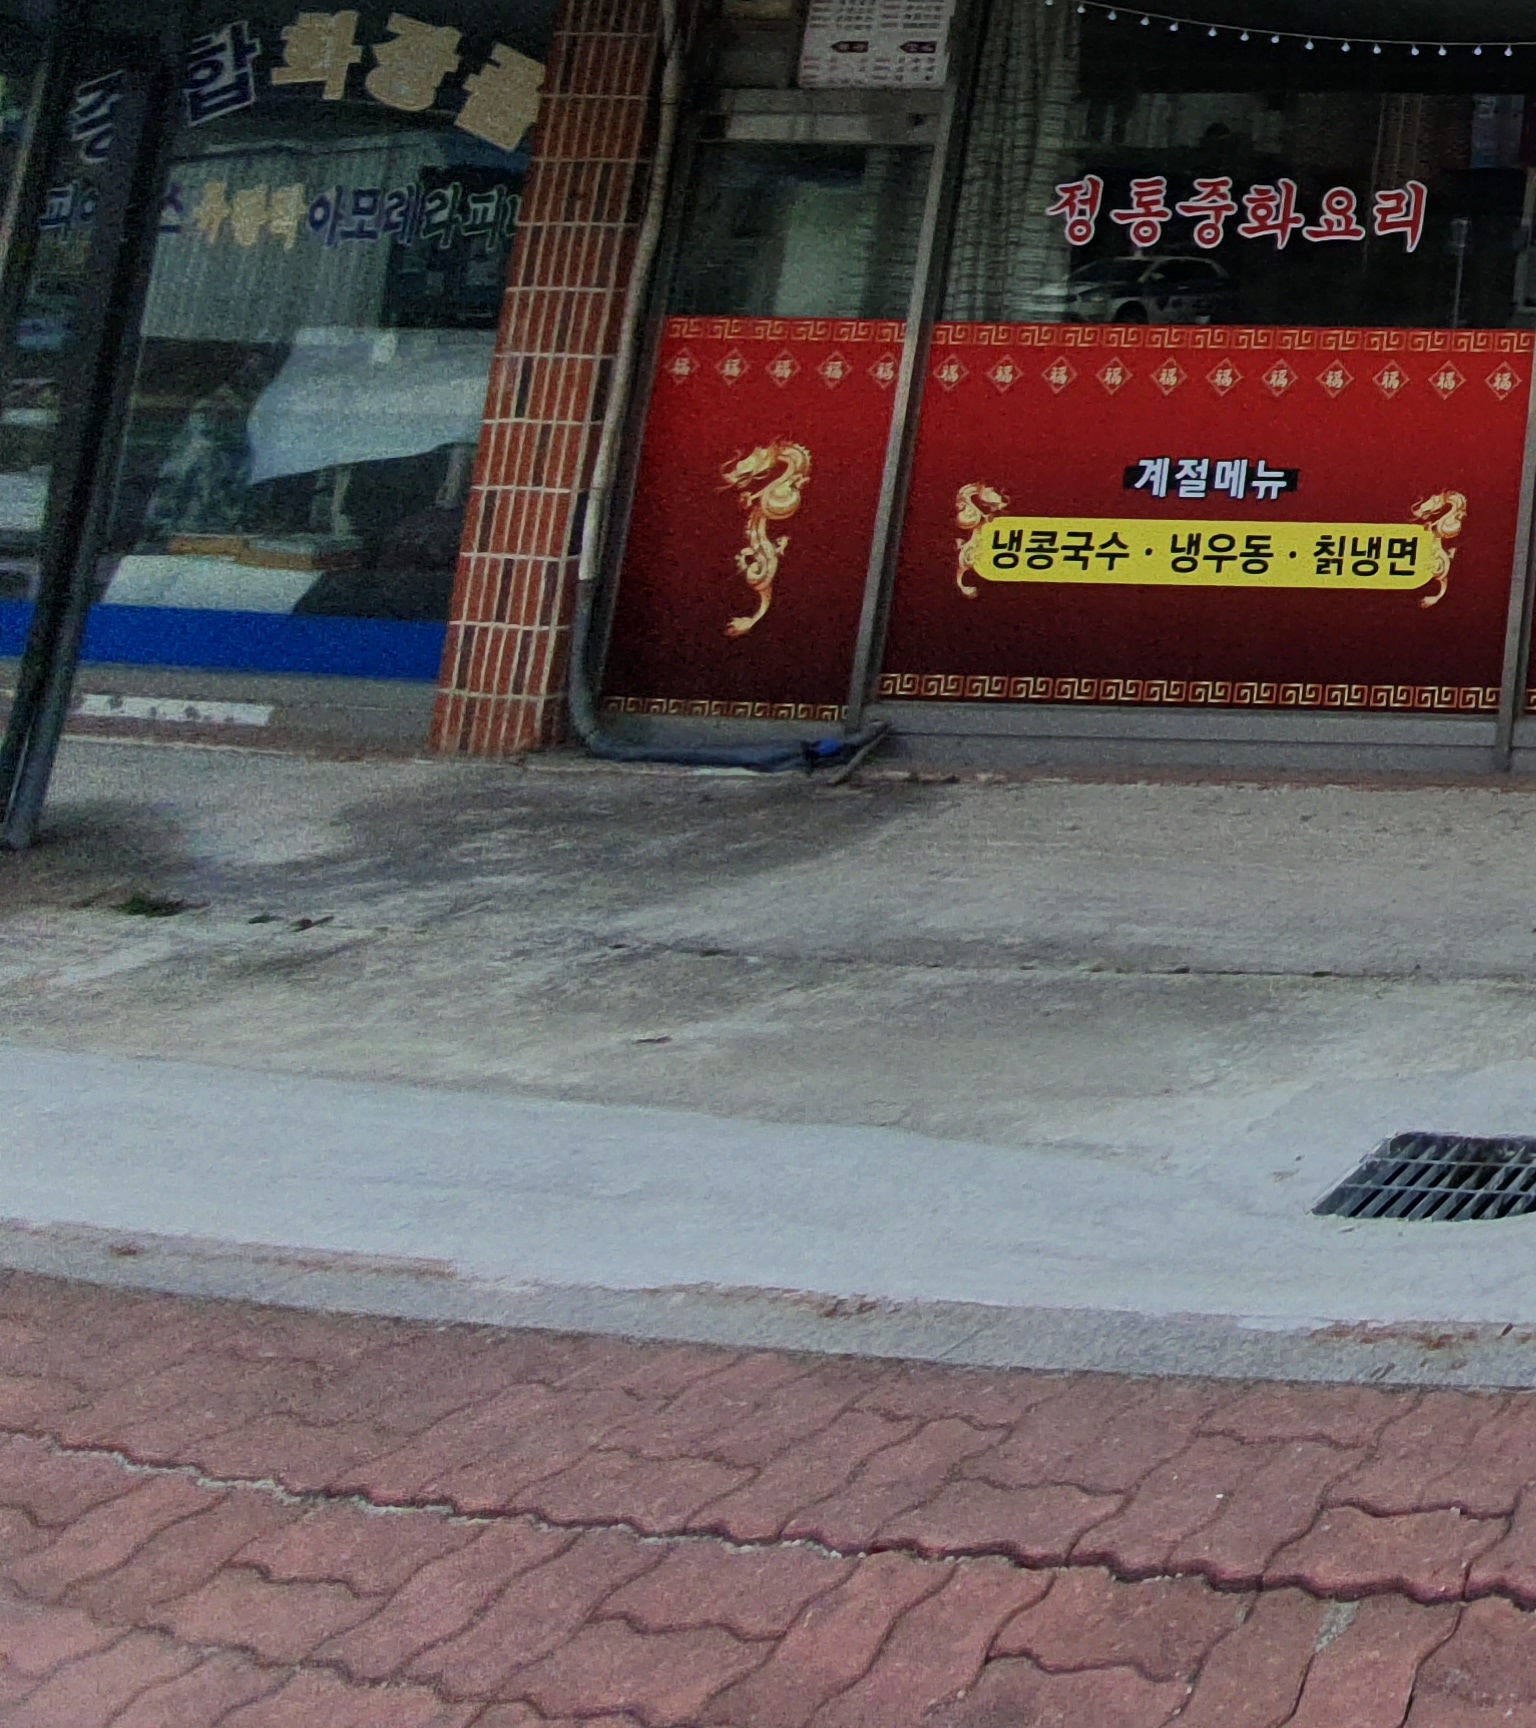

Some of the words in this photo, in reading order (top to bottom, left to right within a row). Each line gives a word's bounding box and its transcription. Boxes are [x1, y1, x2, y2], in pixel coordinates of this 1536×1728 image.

[1047, 174, 1430, 253] 정통중화요리
[1133, 456, 1290, 501] 계절메뉴
[990, 529, 1131, 572] 냉콩국수
[1169, 532, 1275, 575] 냉우동
[1312, 534, 1419, 578] 칡냉면
